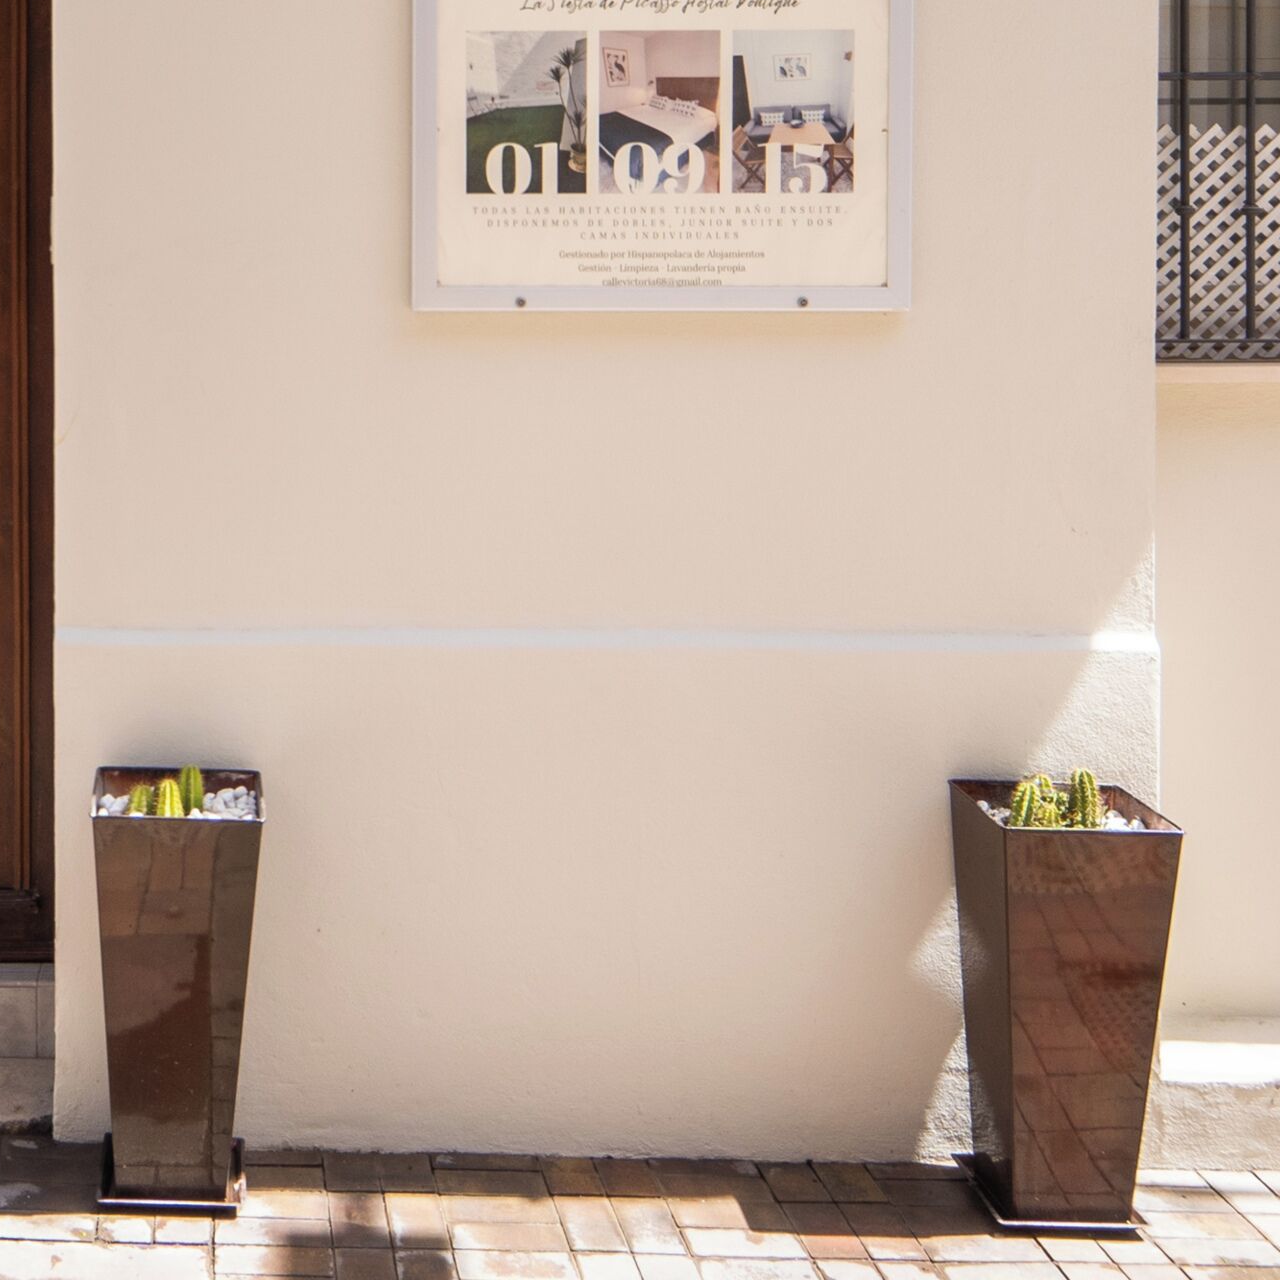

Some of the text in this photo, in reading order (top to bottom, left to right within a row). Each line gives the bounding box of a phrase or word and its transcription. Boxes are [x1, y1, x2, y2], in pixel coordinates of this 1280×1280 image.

[486, 141, 828, 194] 01 09 15
[472, 206, 518, 215] TODAS
[526, 206, 550, 215] LAS
[559, 205, 666, 215] HABITACIONES
[674, 205, 727, 215] TIENEN
[735, 203, 771, 215] BAÑO
[487, 217, 833, 229] DISPONEMOS DE DOBLES, JUNIOR SUITE Y DOS
[580, 231, 740, 240] CAMAS INDIVIDUALES
[559, 249, 609, 259] Gestionado
[610, 251, 626, 261] por
[694, 249, 705, 259] de
[707, 248, 766, 261] Alojamientos
[578, 263, 612, 273] Gestión
[619, 263, 660, 275] Limpieza
[717, 263, 746, 275] propia
